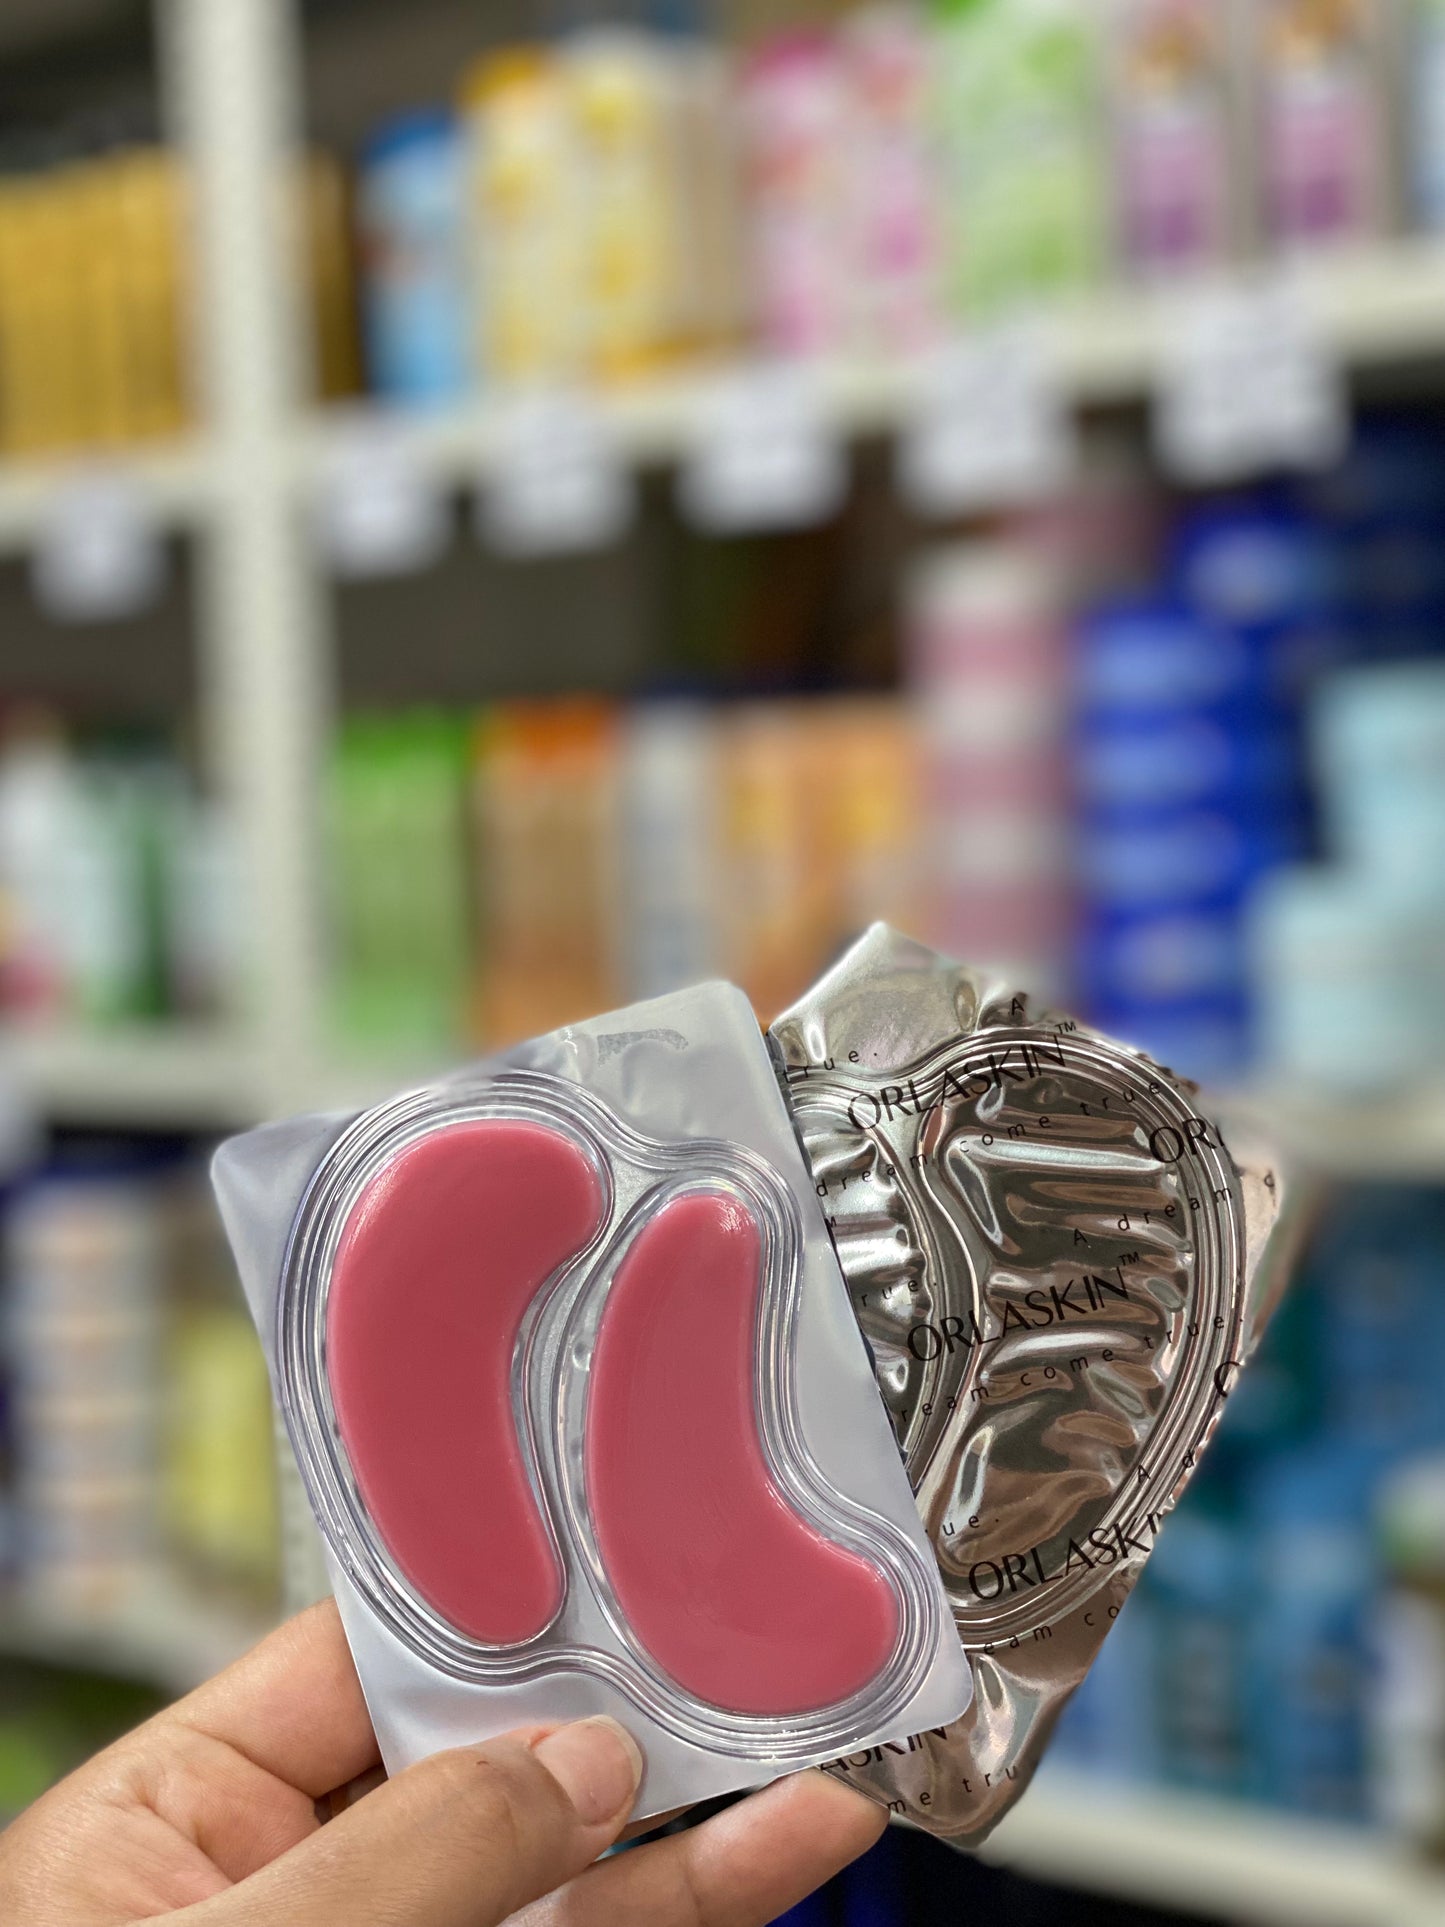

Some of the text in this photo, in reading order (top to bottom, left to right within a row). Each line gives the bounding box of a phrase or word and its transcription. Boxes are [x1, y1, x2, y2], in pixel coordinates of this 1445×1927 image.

[1011, 997, 1024, 1016] A
[782, 1049, 878, 1084] true.
[816, 1081, 1179, 1197] dream come true.
[1073, 1187, 1233, 1246] A dream
[861, 1279, 938, 1308] rue.
[901, 1315, 1243, 1424] ream come true.
[968, 1512, 1163, 1601] ORLASKI
[962, 1765, 1018, 1793] tru
